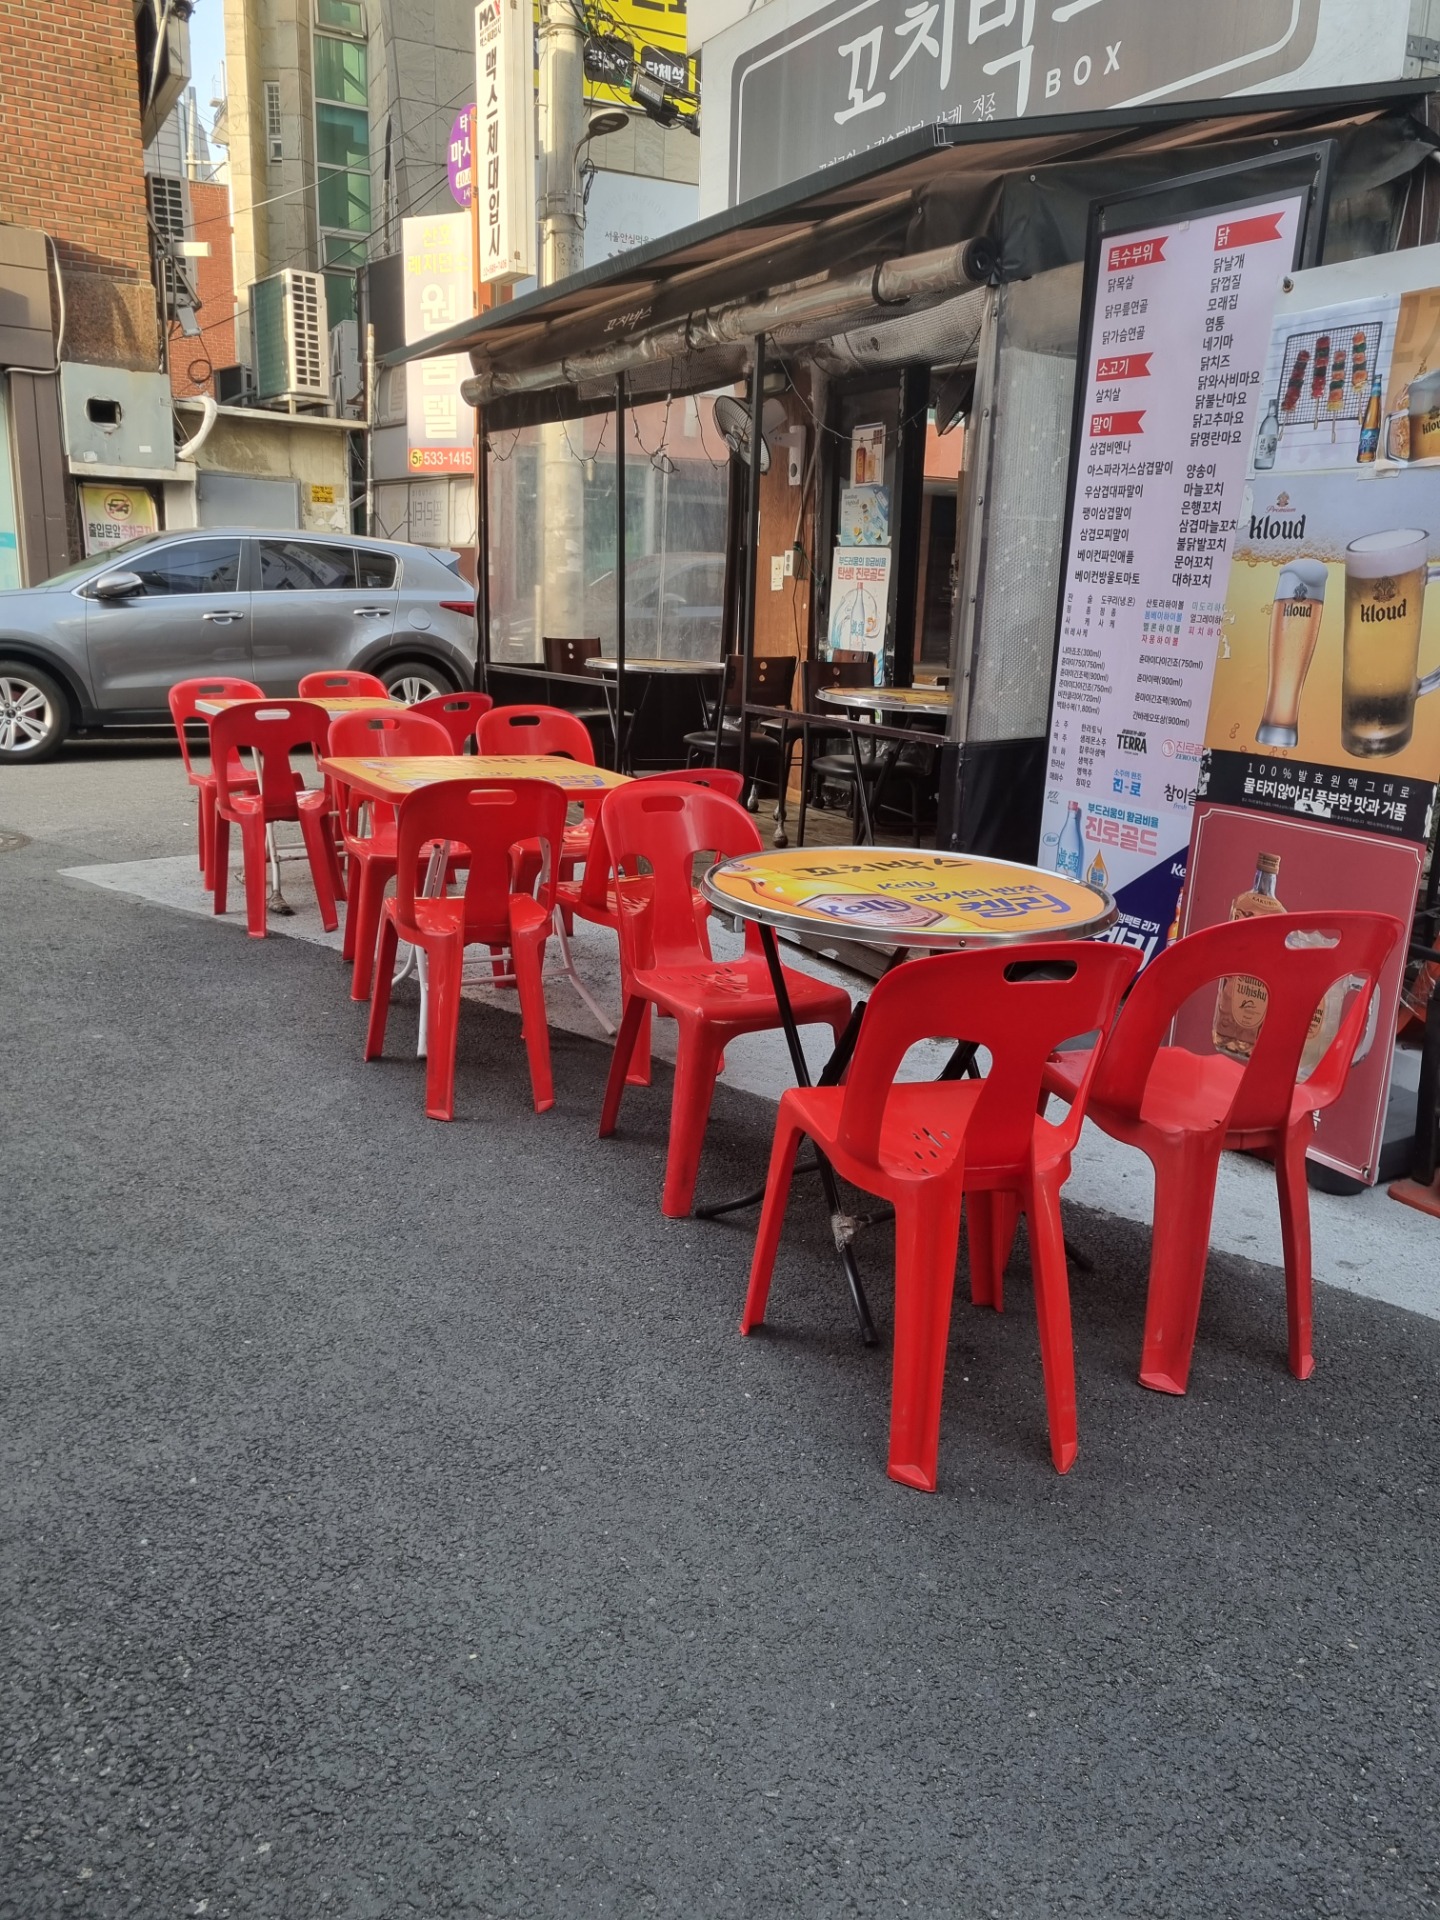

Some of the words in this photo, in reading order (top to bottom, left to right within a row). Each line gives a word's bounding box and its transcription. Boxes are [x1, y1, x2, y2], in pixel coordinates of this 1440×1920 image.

[833, 0, 1105, 125] 꼬치박
[1045, 40, 1122, 97] BOX
[485, 46, 502, 257] 맥스체대입시
[1217, 225, 1230, 247] 닭
[1110, 243, 1154, 267] 특수부위
[1213, 253, 1245, 273] 닭날개
[1107, 275, 1134, 293] 닭목살
[1210, 273, 1242, 293] 닭껍질
[1105, 299, 1148, 319] 닭무릎연골
[1207, 294, 1238, 312] 모래집
[604, 306, 652, 332] 꼬치박스
[1205, 316, 1225, 333] 염통
[1102, 326, 1145, 345] 닭가슴연골
[1203, 334, 1233, 351] 네기마
[1098, 359, 1129, 377] 소고기
[1200, 354, 1231, 372] 닭치즈
[1198, 371, 1260, 391] 닭와사비마요
[1095, 387, 1121, 403] 살치살
[1195, 391, 1247, 409] 닭불난마요
[1093, 416, 1112, 433] 말이
[1193, 411, 1244, 428] 닭고추마요
[1190, 430, 1242, 447] 닭명란마요
[1090, 440, 1131, 456] 삼겹비엔나
[423, 451, 472, 465] 533-1415
[1087, 461, 1173, 477] 아스파라거스삼겹말이
[1186, 463, 1216, 479] 양송이
[1085, 484, 1144, 499] 우삼겹대파말이
[1183, 482, 1224, 496] 마늘꼬치
[1082, 506, 1132, 520] 팽이삼겹말이
[1181, 501, 1222, 515] 은행꼬치
[88, 523, 121, 539] 출입문앞
[1080, 528, 1129, 542] 삼겹모찌말이
[1249, 514, 1307, 541] Kloud
[1177, 537, 1227, 552] 불닭발꼬치
[1077, 549, 1134, 563] 베이컨파인애플
[1174, 555, 1213, 570] 문어꼬치
[856, 568, 886, 581] 진로골드
[1075, 570, 1140, 585] 베이컨방울토마토
[1172, 573, 1212, 588] 대하꼬치
[1283, 604, 1312, 618] Kloud
[1360, 598, 1407, 623] Kloud
[1117, 733, 1147, 754] TERRA
[1314, 788, 1352, 811] 풍부한
[1354, 795, 1380, 816] 맛과
[1382, 801, 1408, 822] 거품
[1088, 803, 1125, 821] 부드러움의
[1127, 811, 1159, 828] 황금비율
[1085, 816, 1158, 856] 진로골드
[792, 858, 973, 877] 꼬치박스
[877, 880, 936, 892] Kelly
[910, 889, 992, 902] 라거의
[990, 885, 1047, 895] 반전
[818, 899, 911, 918] Kelly
[956, 894, 1071, 918] 켈리
[1142, 920, 1160, 934] 라거
[1237, 984, 1267, 1002] Whisky
